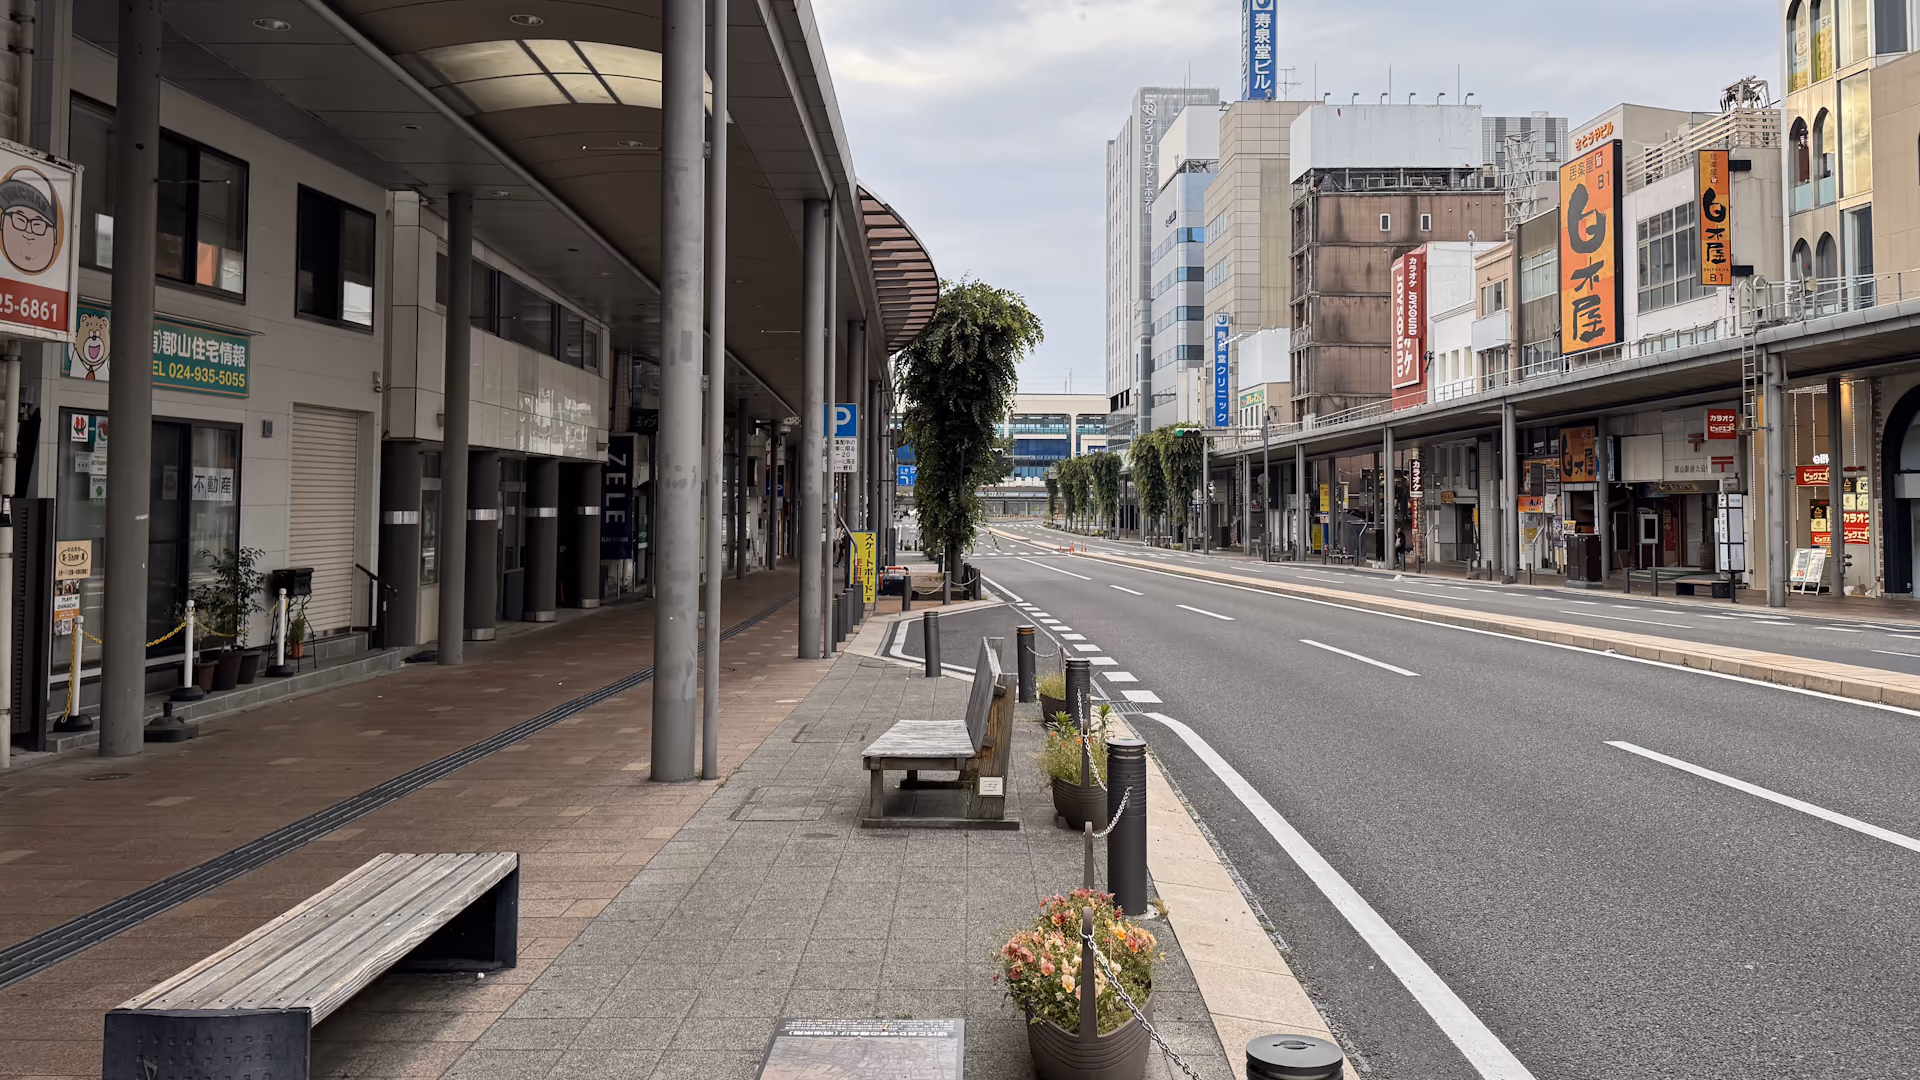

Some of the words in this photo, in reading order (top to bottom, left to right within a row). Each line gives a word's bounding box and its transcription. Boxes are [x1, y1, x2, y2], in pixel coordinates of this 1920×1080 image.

[1254, 13, 1272, 90] 寿泉堂ビル
[1575, 121, 1614, 151] さとうやビル
[1598, 170, 1610, 190] B1
[1703, 187, 1726, 264] 白木屋
[1408, 257, 1417, 288] カラオケ
[1567, 183, 1606, 343] 白木屋
[1709, 273, 1723, 282] B1
[0, 293, 57, 322] 5-6861
[1408, 291, 1417, 336] JOYSOUND
[1396, 274, 1404, 378] JOYSOUND
[152, 360, 166, 377] EL
[169, 362, 246, 388] 024-935-5055
[835, 406, 851, 433] P
[194, 475, 231, 493] 不動産
[605, 453, 627, 523] ZELE
[1412, 461, 1421, 490] カラオケ
[1803, 472, 1829, 481] ビッグエコ
[865, 533, 873, 593] スケートボード
